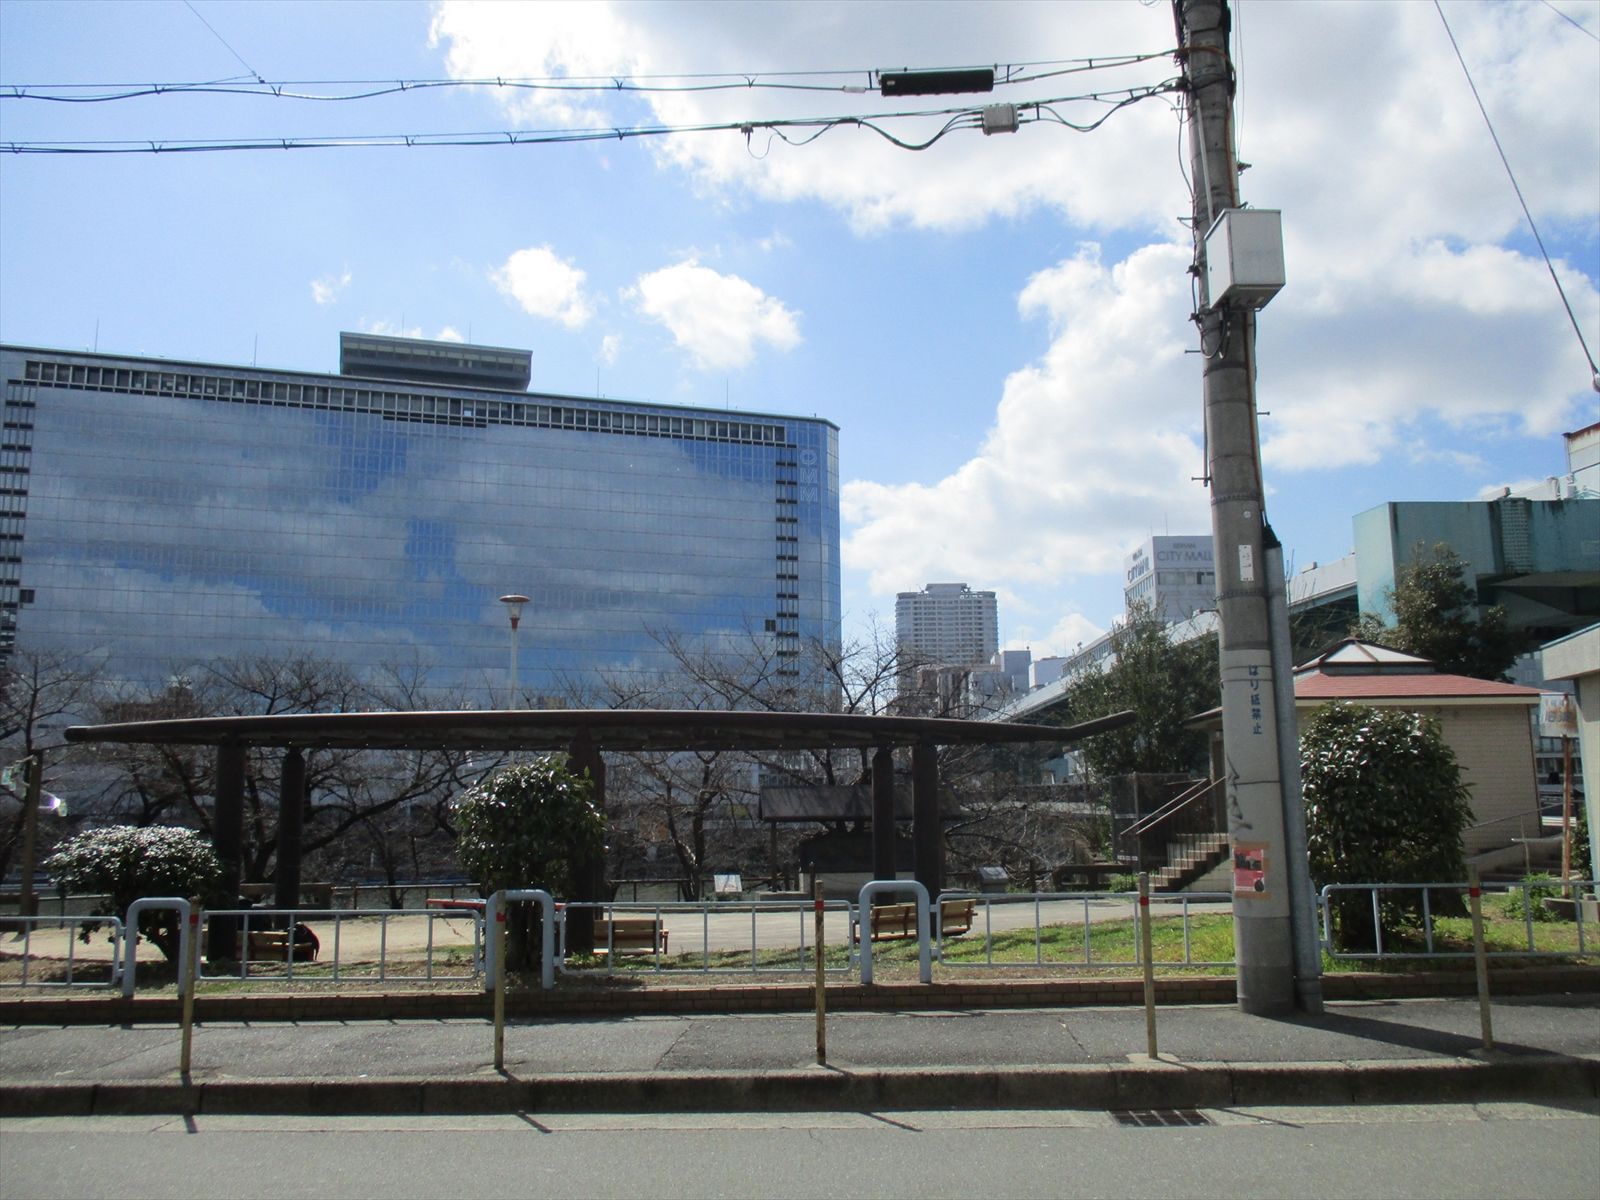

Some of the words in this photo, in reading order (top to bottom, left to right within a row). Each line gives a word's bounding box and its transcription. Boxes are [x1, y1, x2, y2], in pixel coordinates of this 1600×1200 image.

[1157, 551, 1181, 561] CITY
[1184, 551, 1213, 561] MALL
[1248, 664, 1262, 735] はり紙禁止
